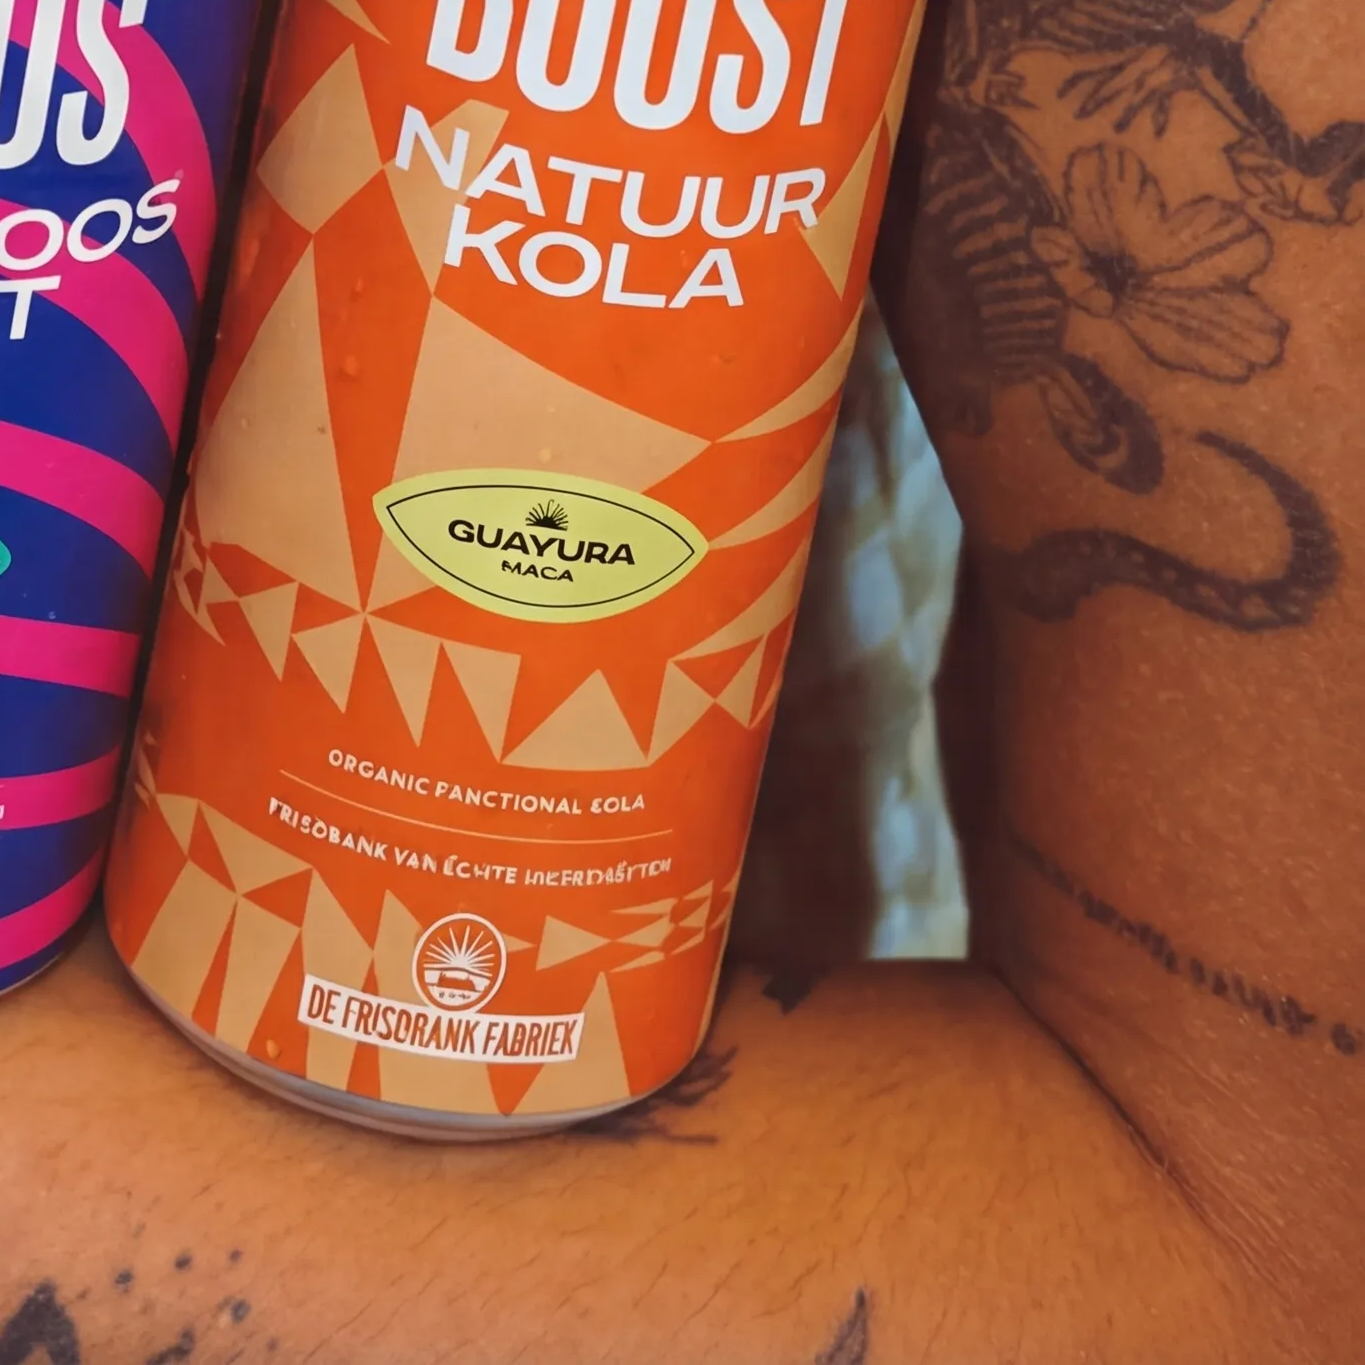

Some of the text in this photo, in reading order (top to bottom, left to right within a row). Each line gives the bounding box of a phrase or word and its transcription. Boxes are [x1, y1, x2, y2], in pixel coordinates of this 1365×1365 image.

[394, 103, 827, 240] NATUUR
[443, 202, 745, 310] KOLA
[446, 518, 636, 567] GUAYURA
[500, 559, 574, 584] MACA
[327, 747, 432, 796] ORGANIC
[393, 845, 438, 875] VAN
[306, 983, 342, 1025] DE
